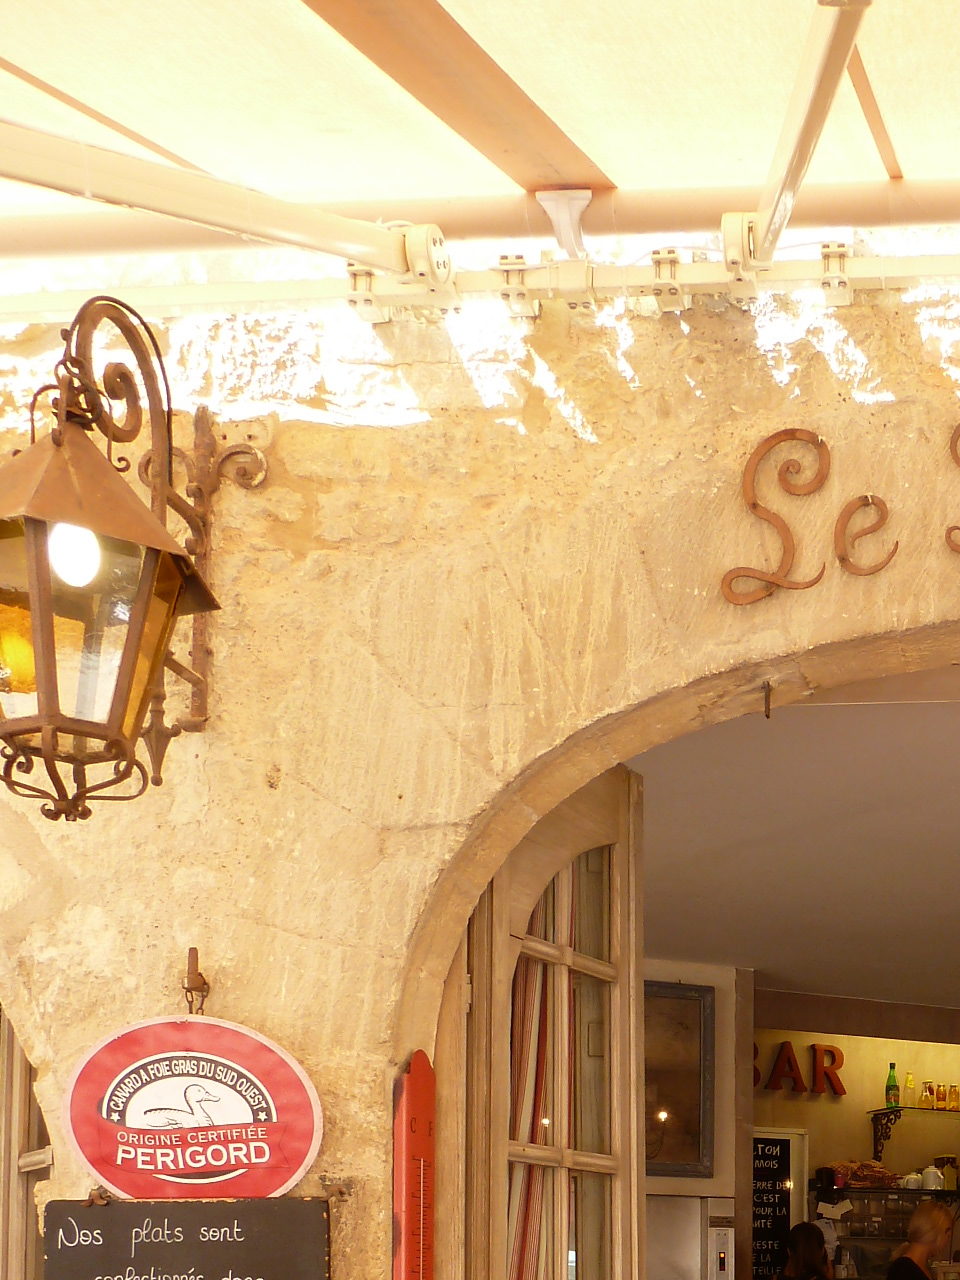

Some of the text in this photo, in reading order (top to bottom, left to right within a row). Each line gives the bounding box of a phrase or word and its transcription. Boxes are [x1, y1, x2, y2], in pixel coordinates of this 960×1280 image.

[721, 428, 898, 606] Le
[110, 1075, 143, 1111] CANARD
[148, 1061, 172, 1078] FOIE
[172, 1059, 198, 1074] GRAS
[200, 1061, 215, 1077] DU
[215, 1066, 238, 1086] SUD
[236, 1078, 268, 1110] OUEST
[754, 1041, 847, 1095] AR
[116, 1141, 271, 1170] PERIGORD
[117, 1125, 268, 1145] ORIGINE CERTIFIÉE
[755, 1160, 778, 1169] MOIS
[58, 1217, 245, 1258] Nos plats sont
